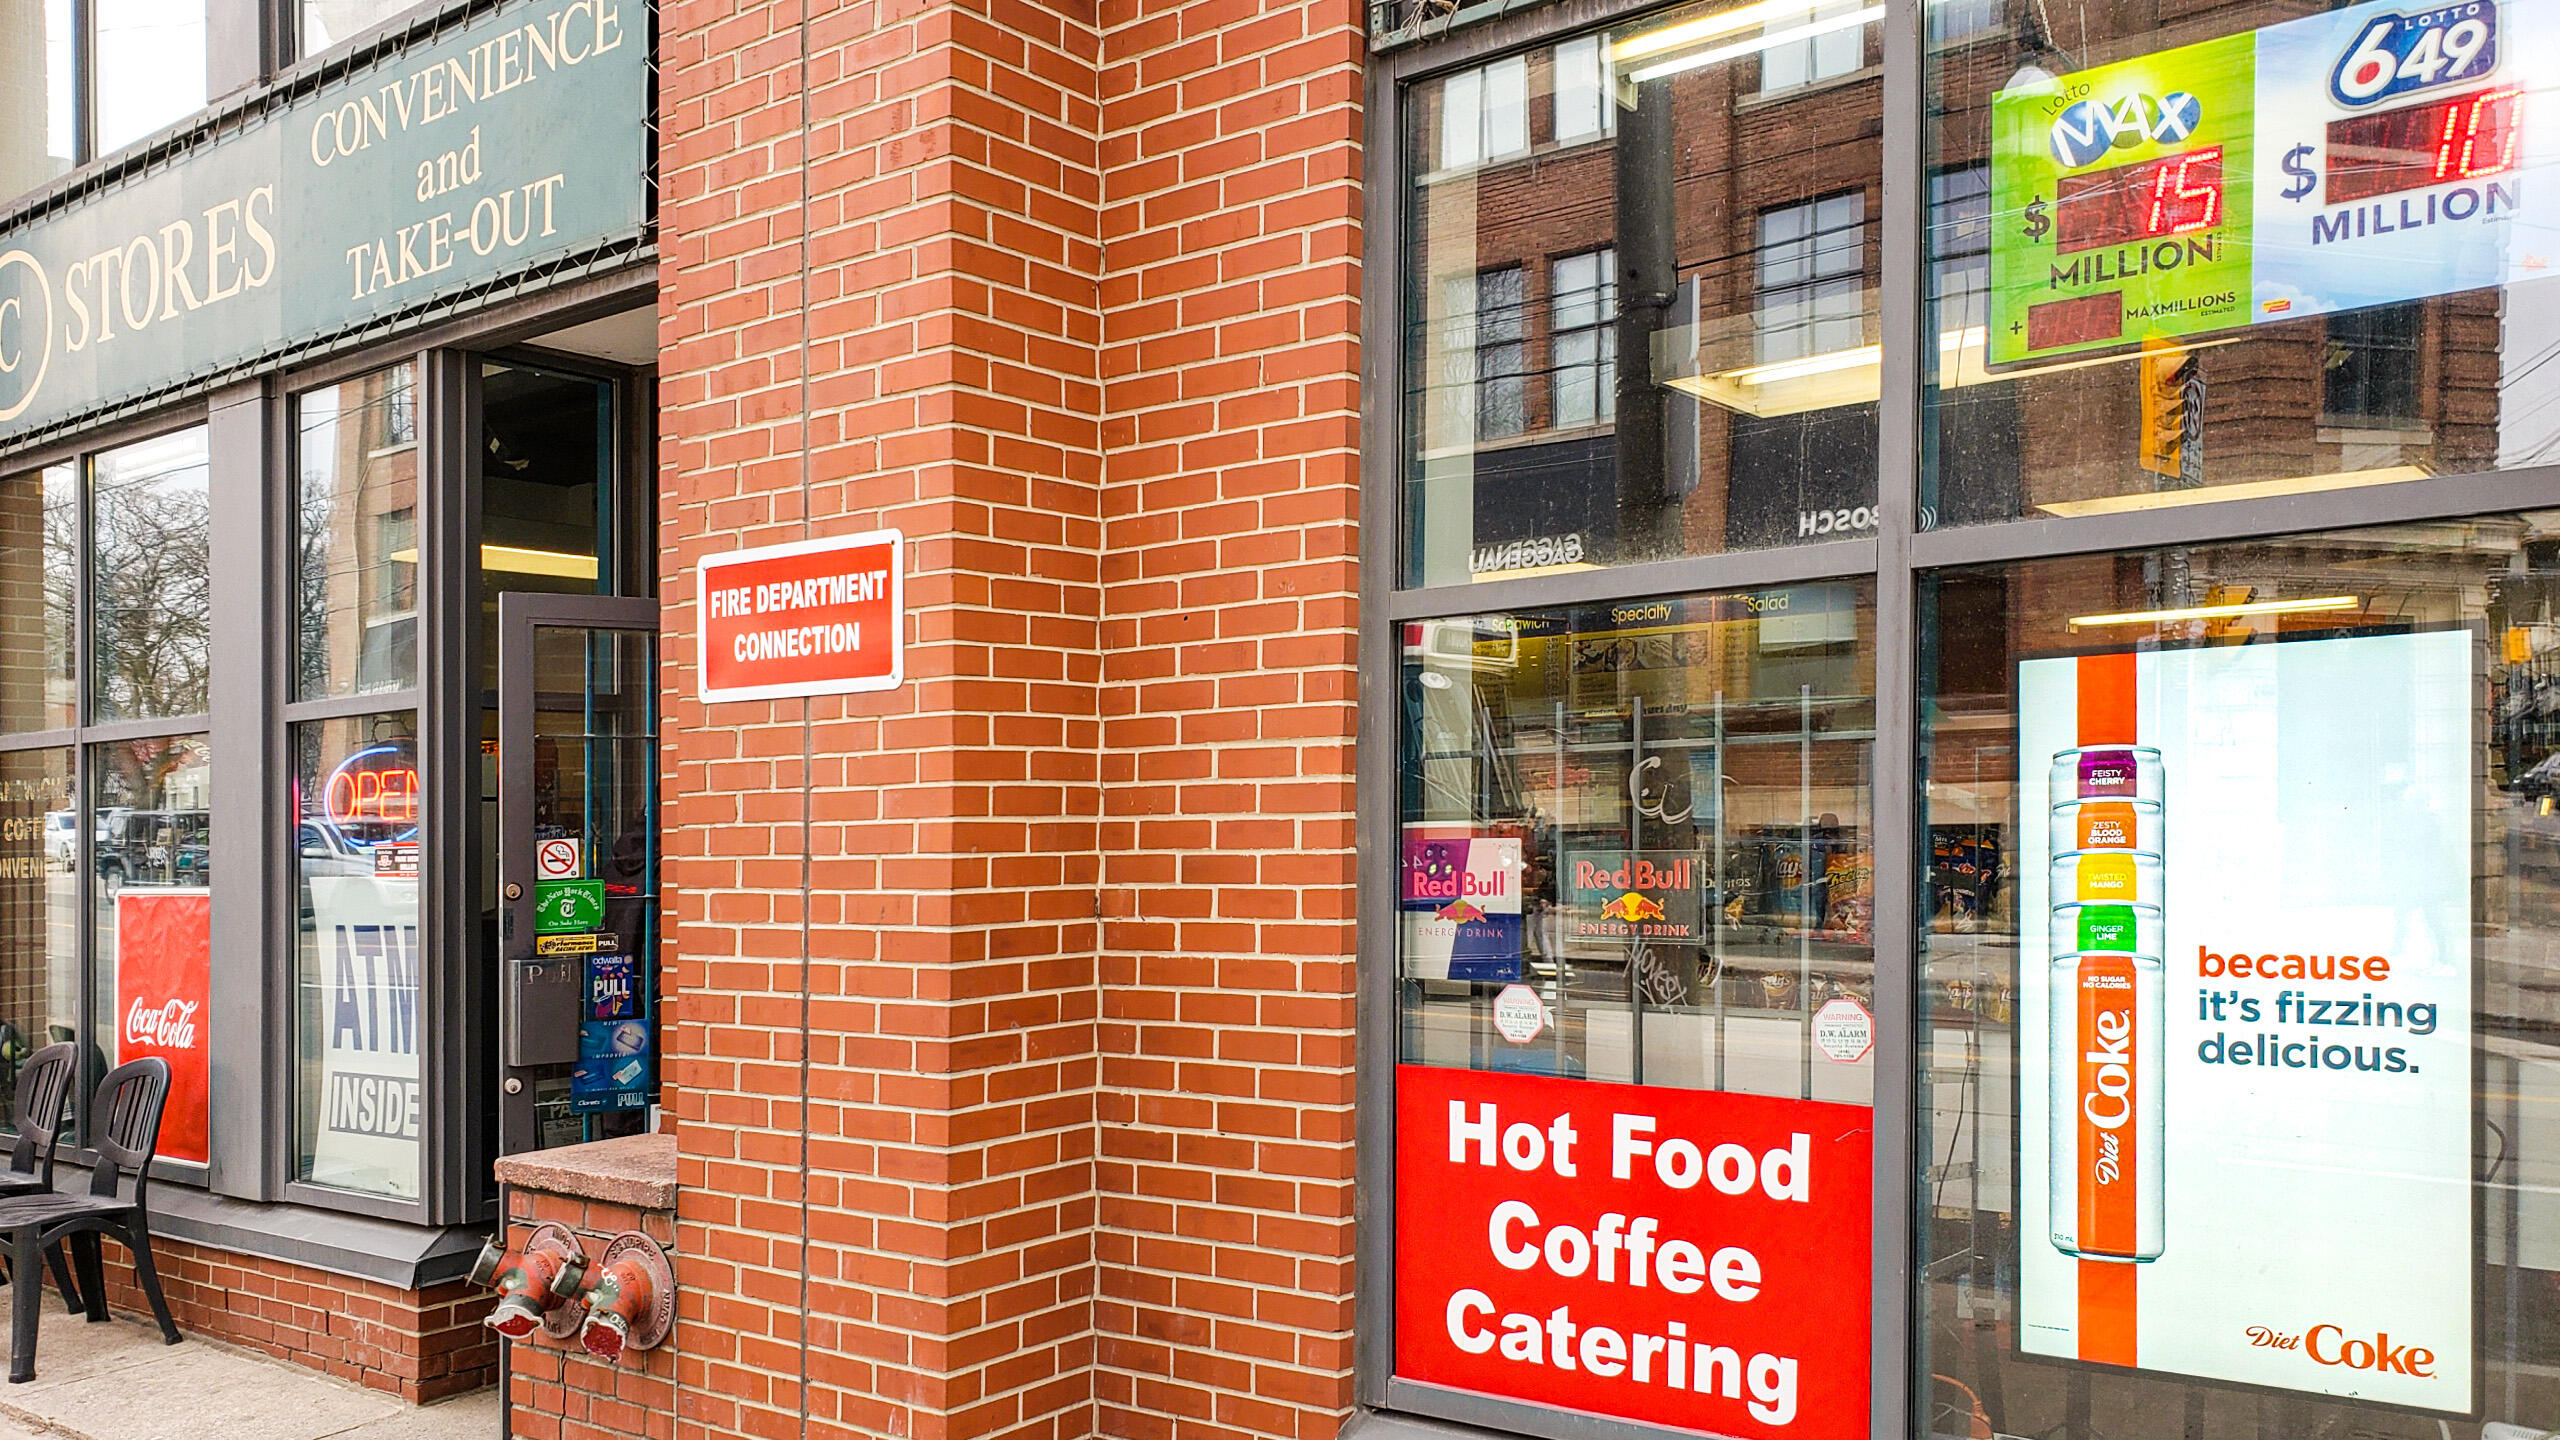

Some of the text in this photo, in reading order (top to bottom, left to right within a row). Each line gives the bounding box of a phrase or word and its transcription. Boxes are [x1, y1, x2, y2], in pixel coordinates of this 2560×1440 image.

[2404, 4, 2480, 31] LOTTO
[310, 0, 623, 167] CONVENIENCE
[2042, 83, 2091, 116] Lotto
[2051, 92, 2193, 167] MAX
[2279, 89, 2524, 203] $ 10
[416, 124, 482, 203] and
[2022, 150, 2219, 243] $ 15
[2312, 178, 2522, 245] MILLION
[346, 174, 565, 301] TAKE-OUT
[64, 184, 276, 353] STORES
[2050, 233, 2214, 290] MILLION
[2126, 291, 2237, 320] MAXMILLIONS
[2200, 305, 2236, 317] ESTIMATED
[711, 569, 888, 619] FIRE DEPARTMENT
[1747, 594, 1789, 613] Salad
[1610, 603, 1673, 625] Specialty
[733, 621, 861, 662] CONNECTION
[2089, 777, 2126, 786] CHERRY
[2091, 769, 2122, 778] FEISTY
[2091, 829, 2123, 837] BLOOD
[2094, 821, 2121, 829] ZESTY
[2087, 836, 2127, 844] ORANGE
[1413, 870, 1505, 896] Red Bull
[1576, 859, 1692, 890] Red Bull
[2089, 880, 2124, 888] MANGO
[546, 889, 564, 902] New
[563, 887, 584, 897] York
[582, 890, 601, 911] Times
[598, 939, 616, 947] PULL
[1418, 926, 1504, 939] ENERGY DRINK
[1578, 922, 1691, 937] ENERGY DRINK
[2089, 925, 2124, 933] GINGER
[2096, 932, 2117, 941] LIME
[2198, 945, 2391, 983] because
[593, 977, 630, 997] PULL
[2082, 981, 2132, 990] NO CALORIES
[2087, 975, 2126, 983] NO SUGAR
[125, 996, 199, 1049] Coca-Cola
[1514, 1012, 1538, 1020] ALARM
[1823, 1013, 1863, 1021] WARNING
[2198, 989, 2438, 1036] it's fizzing
[1838, 1030, 1867, 1038] ALARM
[2197, 1031, 2420, 1075] delicious.
[330, 1075, 420, 1138] INSIDE
[617, 1092, 645, 1107] PULL
[2084, 1009, 2131, 1186] Diet Coke
[1448, 1099, 1812, 1203] Hot Food
[1488, 1200, 1762, 1303] Coffee
[1446, 1288, 1799, 1427] Catering
[2245, 1323, 2438, 1380] Diet Coke
